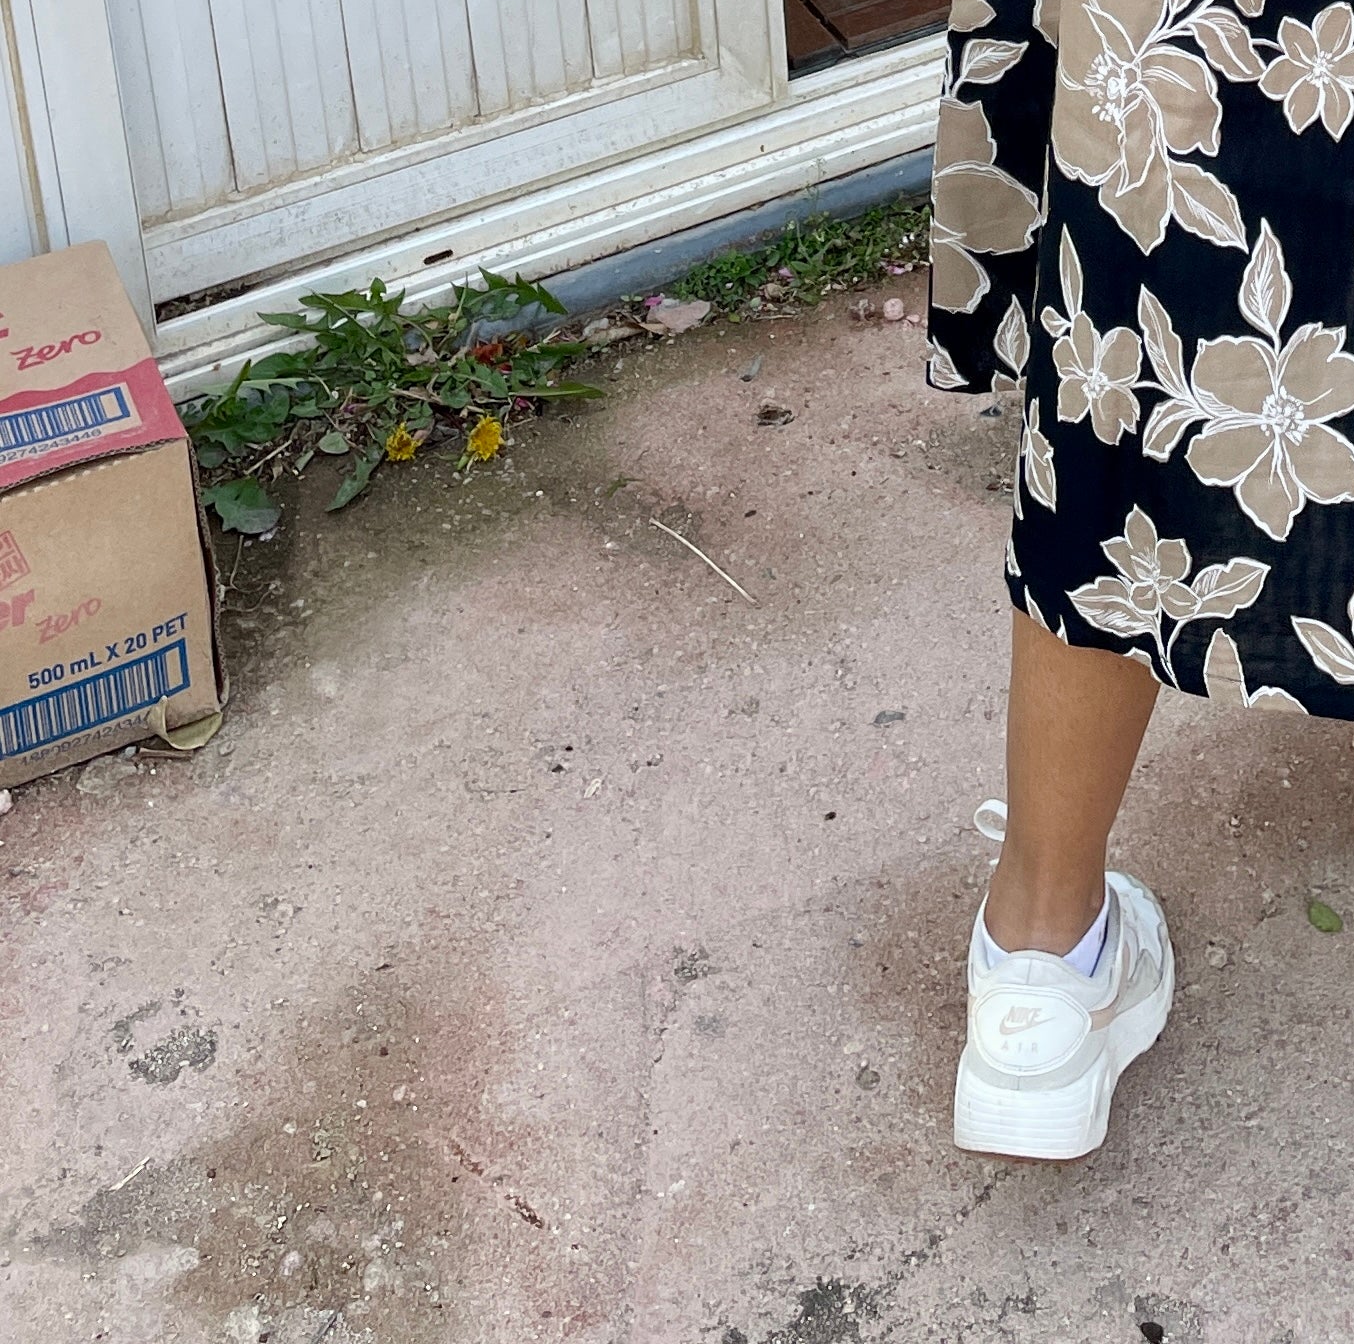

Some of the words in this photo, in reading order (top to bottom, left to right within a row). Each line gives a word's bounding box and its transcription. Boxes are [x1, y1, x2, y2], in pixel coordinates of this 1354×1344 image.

[10, 330, 102, 371] zero
[35, 598, 102, 645] zero
[28, 663, 65, 690] 500
[70, 652, 102, 675] mL
[105, 642, 120, 661] X
[124, 632, 147, 655] 20
[152, 612, 188, 643] PET
[1006, 1006, 1042, 1025] NIKE
[1001, 1040, 1038, 1054] AIR
